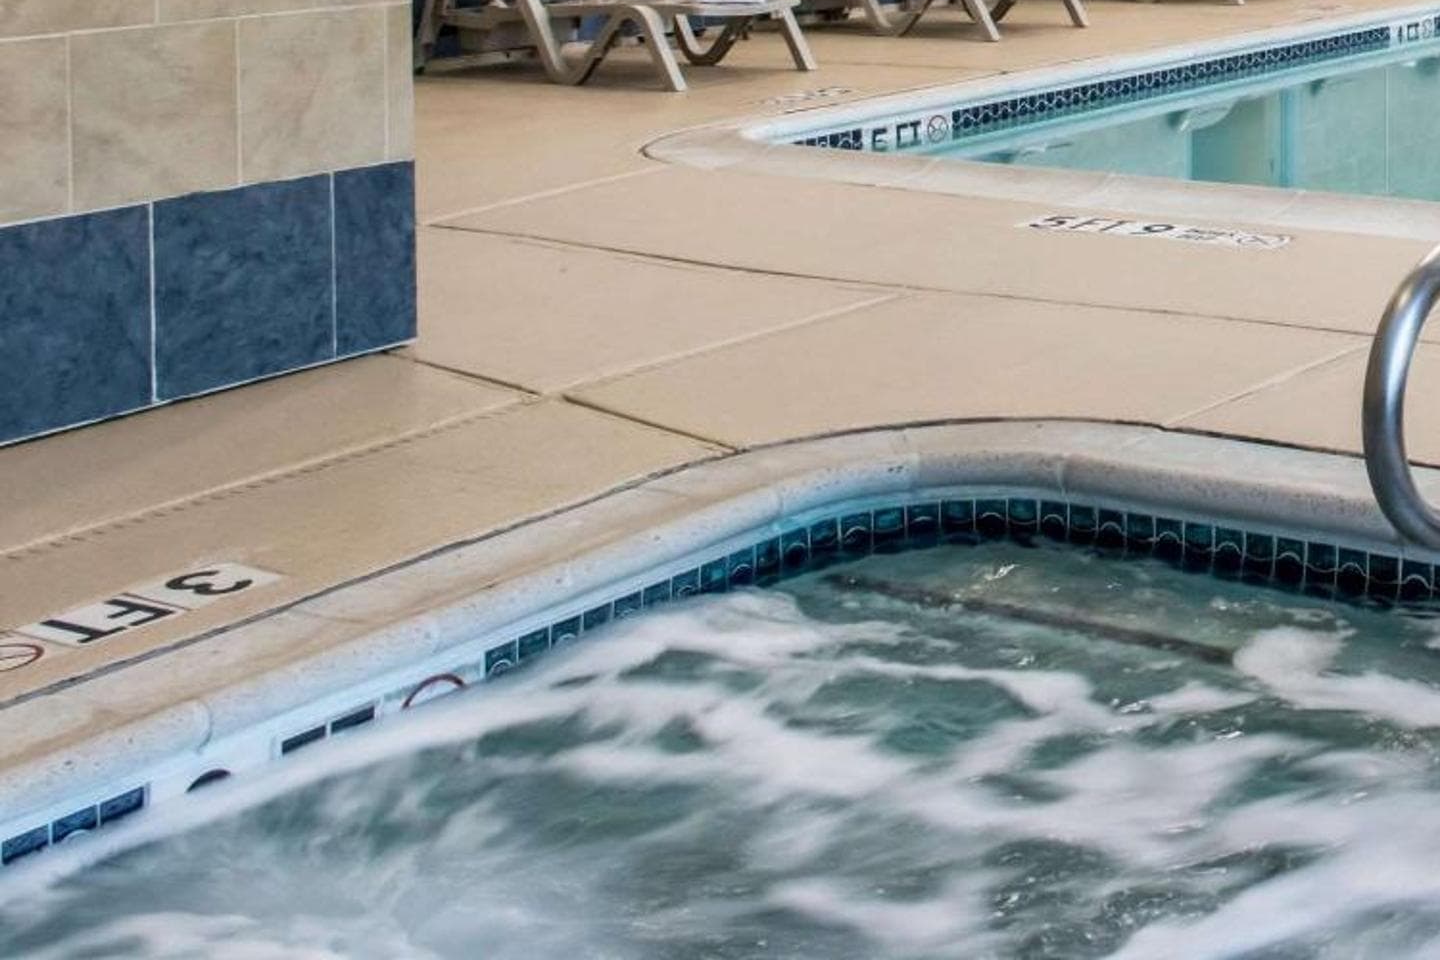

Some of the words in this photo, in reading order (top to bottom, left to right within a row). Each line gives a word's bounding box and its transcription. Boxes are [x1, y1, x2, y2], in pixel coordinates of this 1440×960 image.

[1029, 216, 1076, 228] 5
[165, 569, 253, 596] 3
[41, 598, 176, 644] FT
